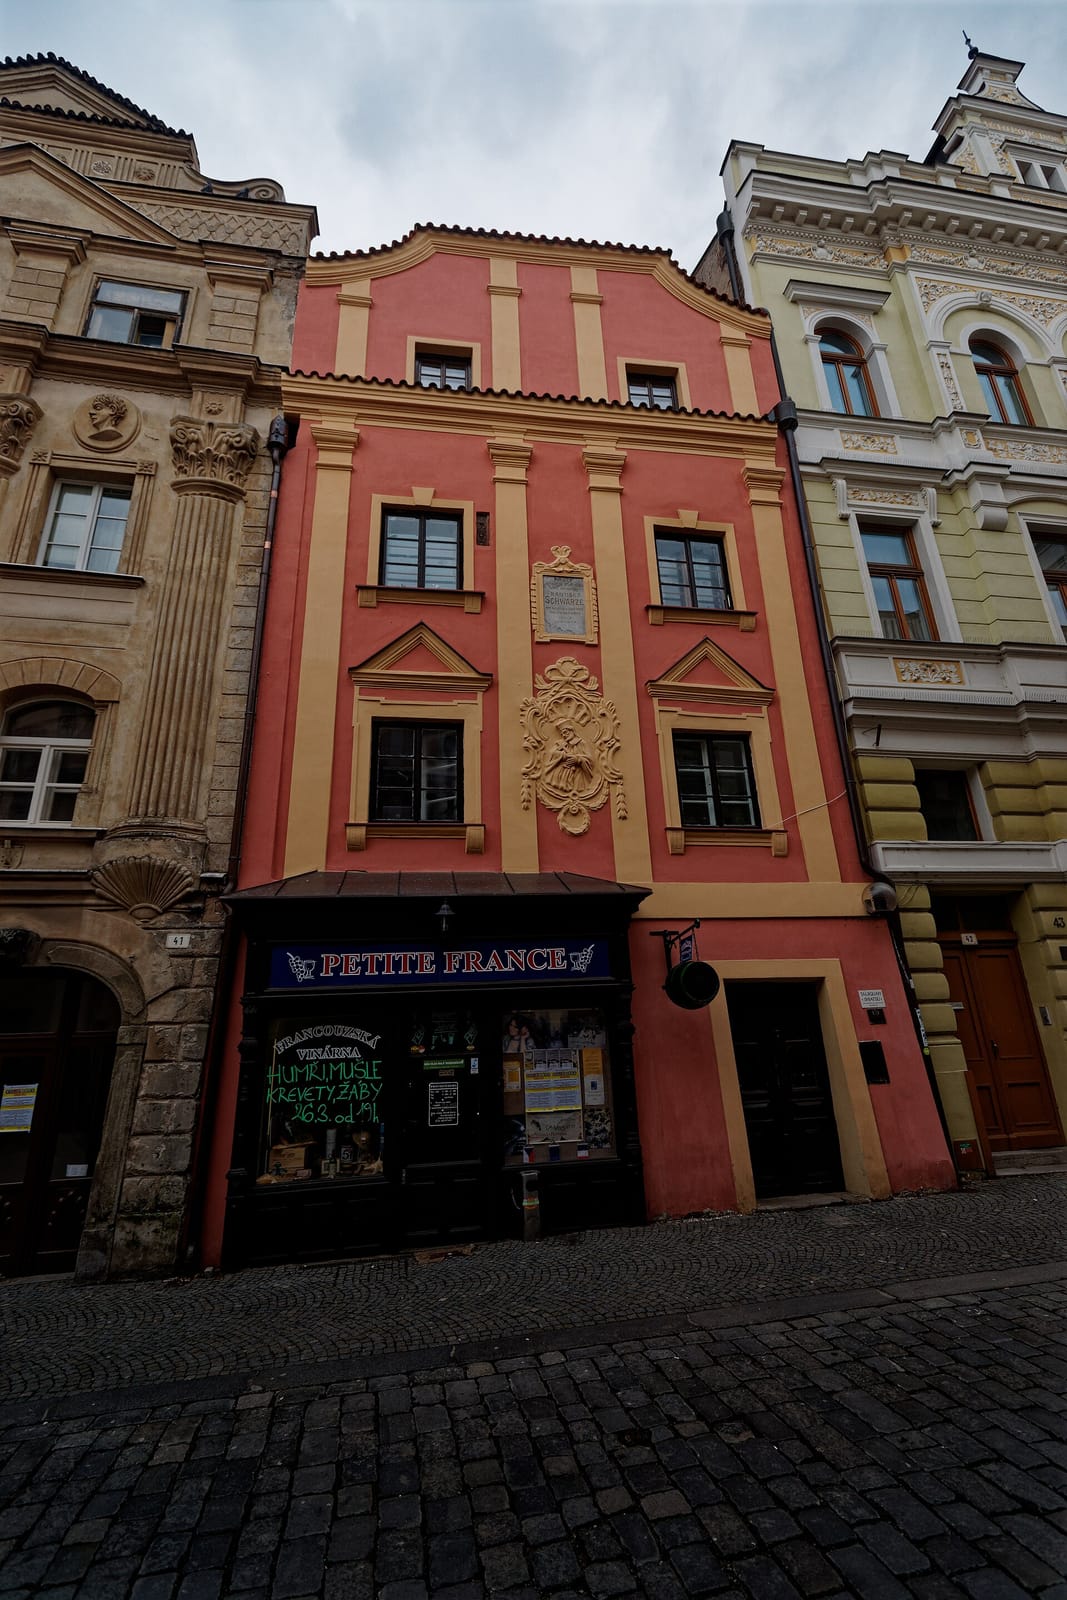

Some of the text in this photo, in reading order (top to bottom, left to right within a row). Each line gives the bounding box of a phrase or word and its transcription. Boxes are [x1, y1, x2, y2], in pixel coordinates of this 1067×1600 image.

[1053, 917, 1065, 929] 43
[172, 936, 184, 946] 41
[320, 948, 567, 976] PETITE FRANCE
[273, 1025, 382, 1054] FRANCOUZSKÁ
[296, 1045, 361, 1060] VINÁRNA
[335, 1103, 355, 1123] od
